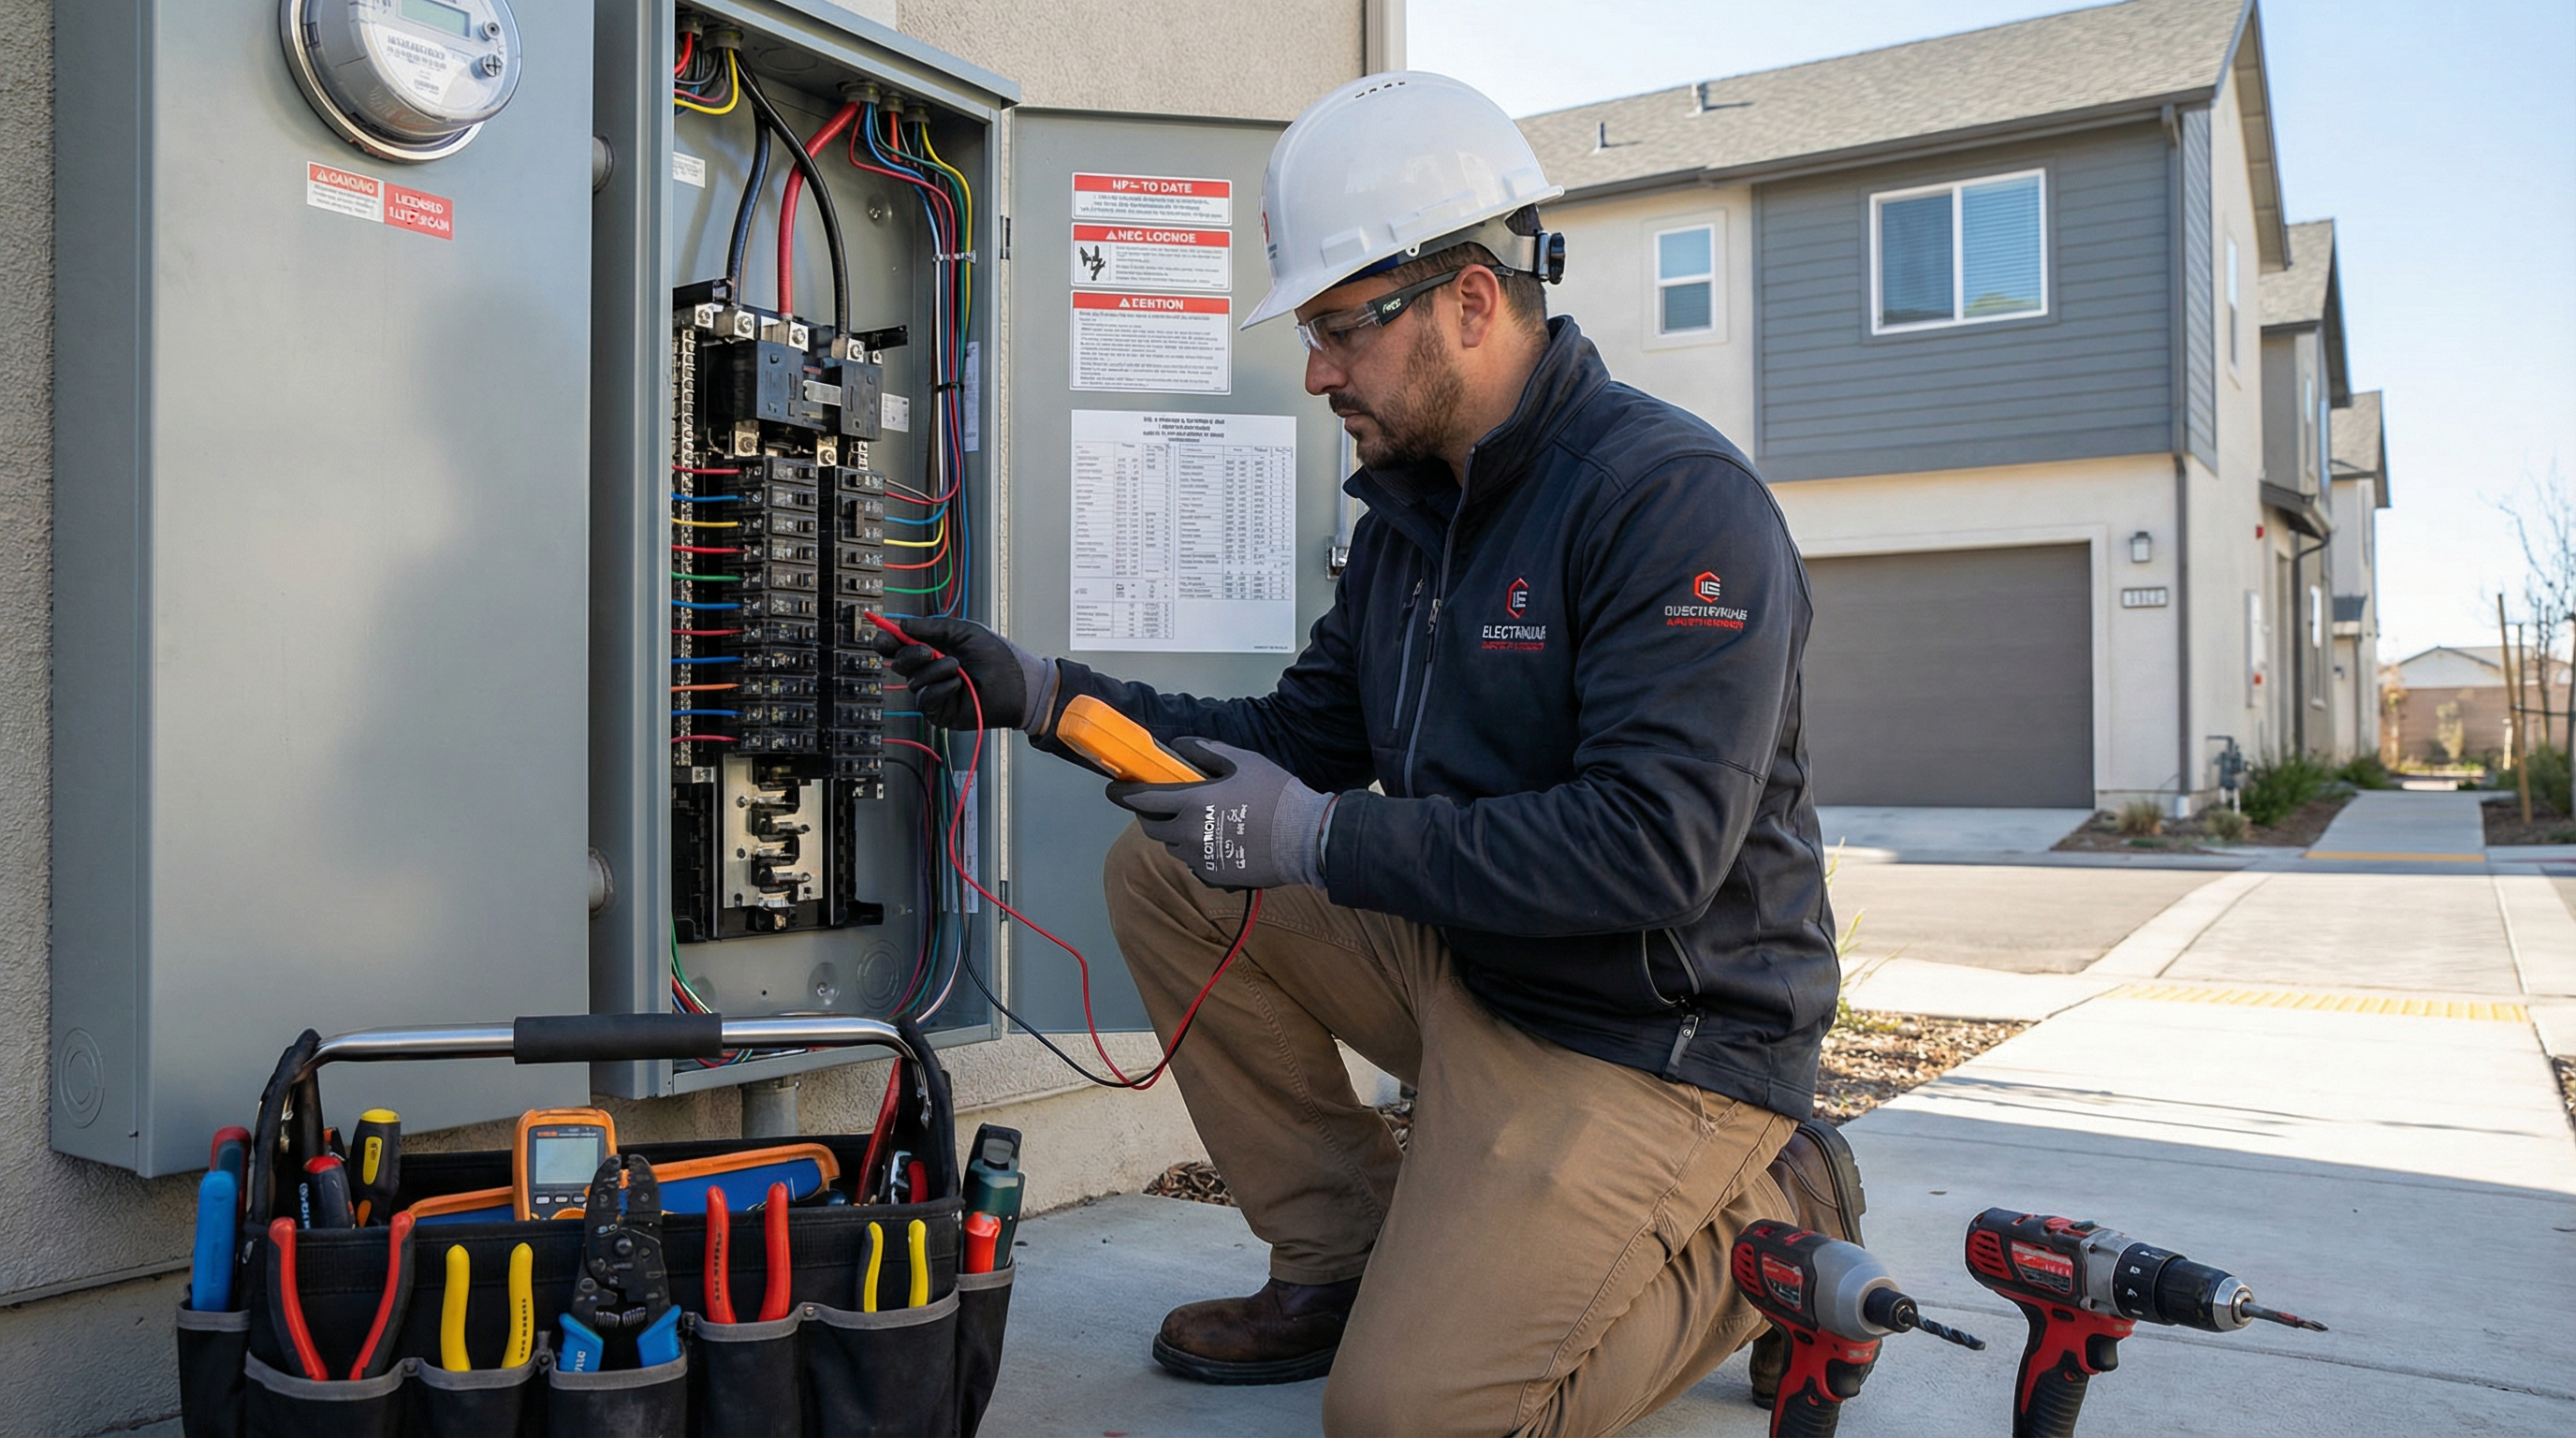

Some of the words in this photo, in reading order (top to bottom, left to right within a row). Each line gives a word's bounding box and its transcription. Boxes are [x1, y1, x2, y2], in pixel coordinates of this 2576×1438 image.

[1141, 181, 1159, 193] TO
[1161, 182, 1193, 194] DATE
[1118, 229, 1144, 242] NEC
